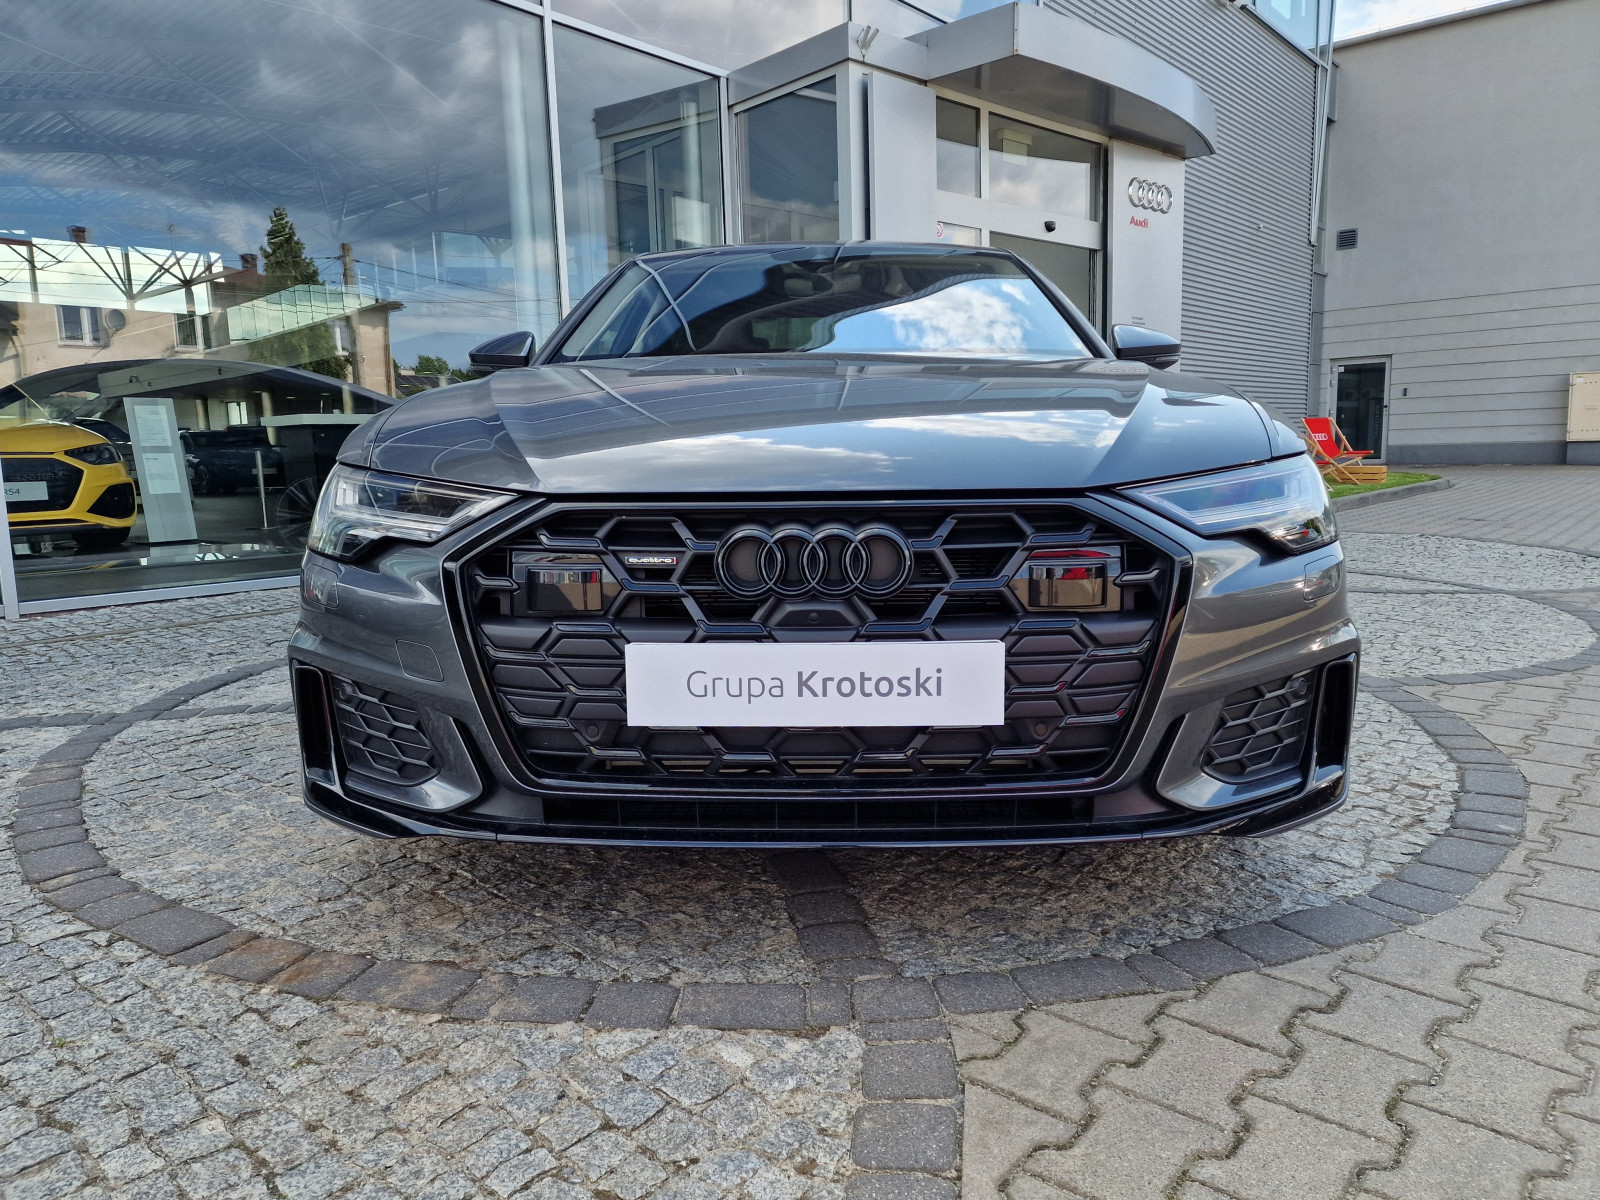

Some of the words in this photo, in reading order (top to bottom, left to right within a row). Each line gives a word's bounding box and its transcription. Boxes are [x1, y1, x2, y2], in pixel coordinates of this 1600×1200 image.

[1130, 216, 1149, 228] Audi
[4, 488, 20, 496] RS4
[628, 557, 672, 565] quattro
[686, 670, 784, 704] Grupa
[797, 667, 943, 698] Krotoski
